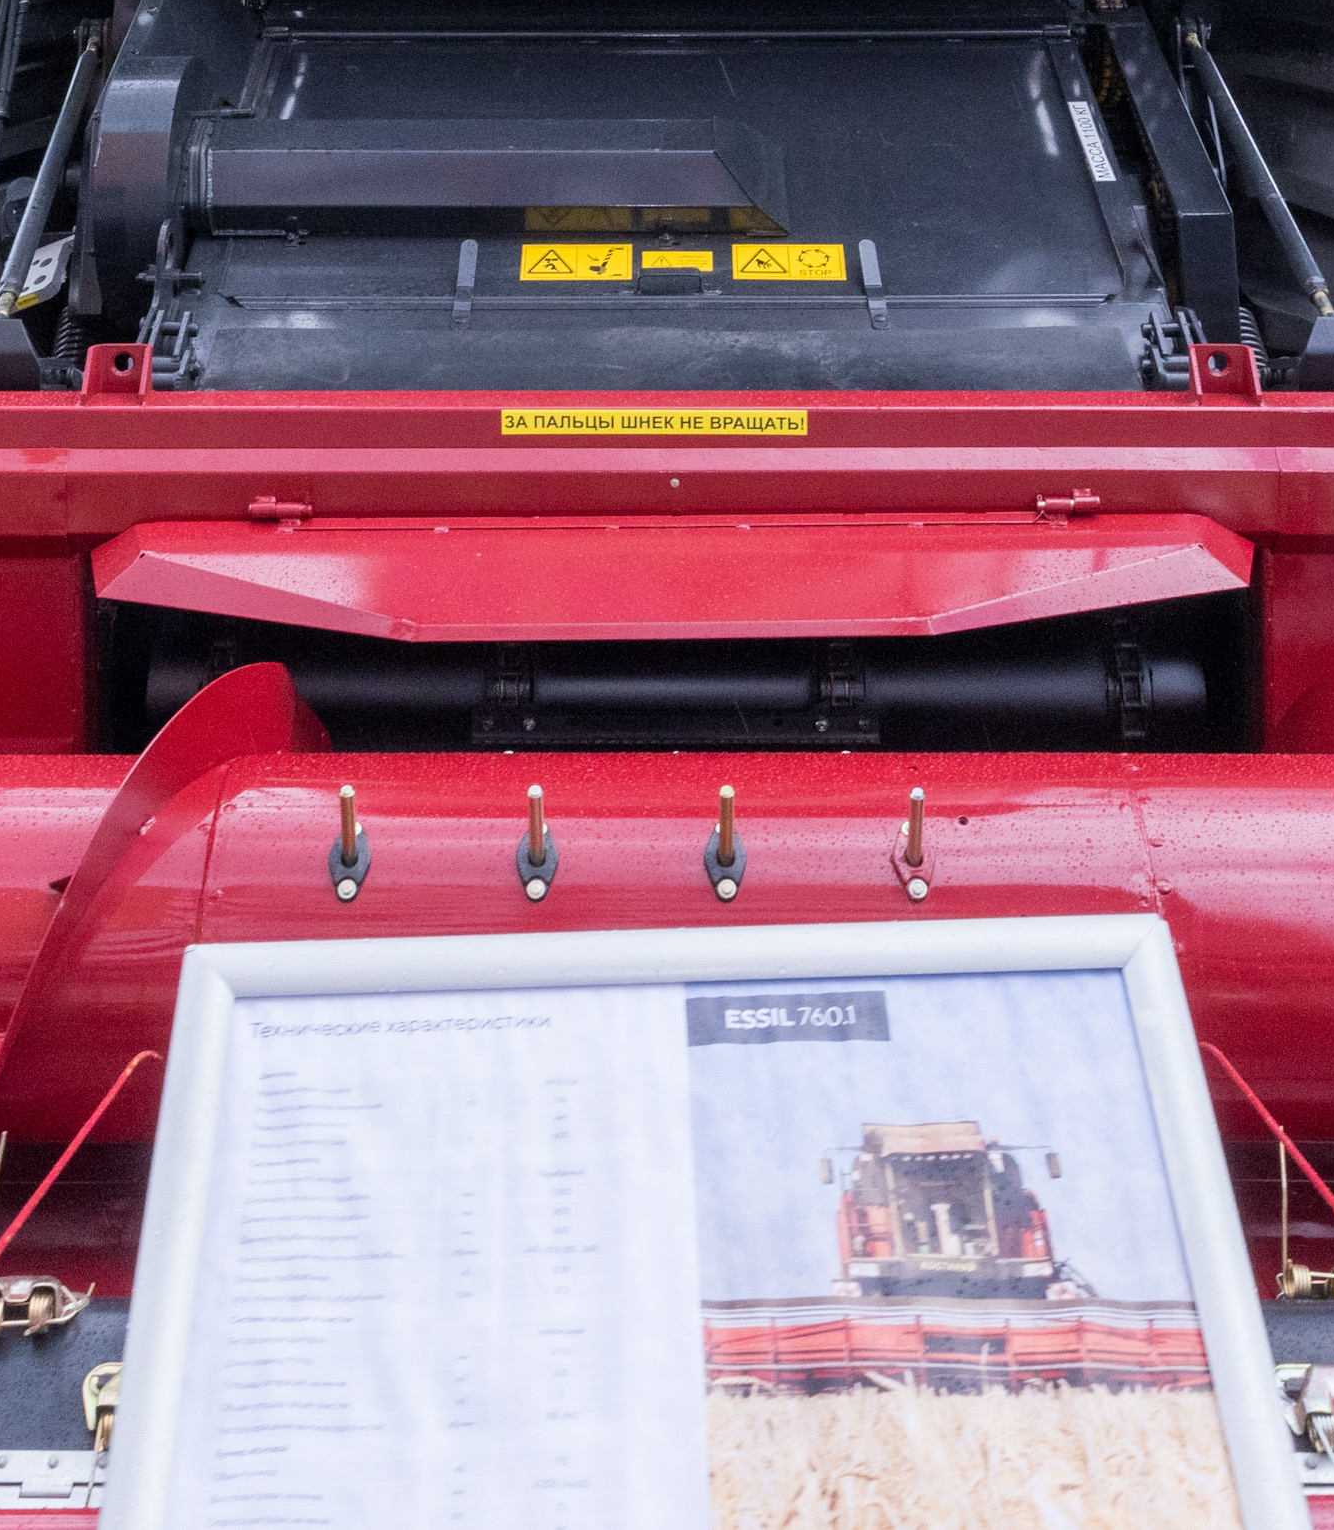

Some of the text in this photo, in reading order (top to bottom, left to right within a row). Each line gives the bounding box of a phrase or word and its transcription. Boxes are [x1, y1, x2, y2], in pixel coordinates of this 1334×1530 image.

[1072, 104, 1112, 179] МАССА 1100 КГ
[504, 415, 805, 432] ЗА ПАЛЬЦЫ ШНЕК НЕ ВРАЩАТЬ!
[249, 1016, 553, 1039] Технические характеристики
[724, 1005, 857, 1030] ESSIL 760.1
